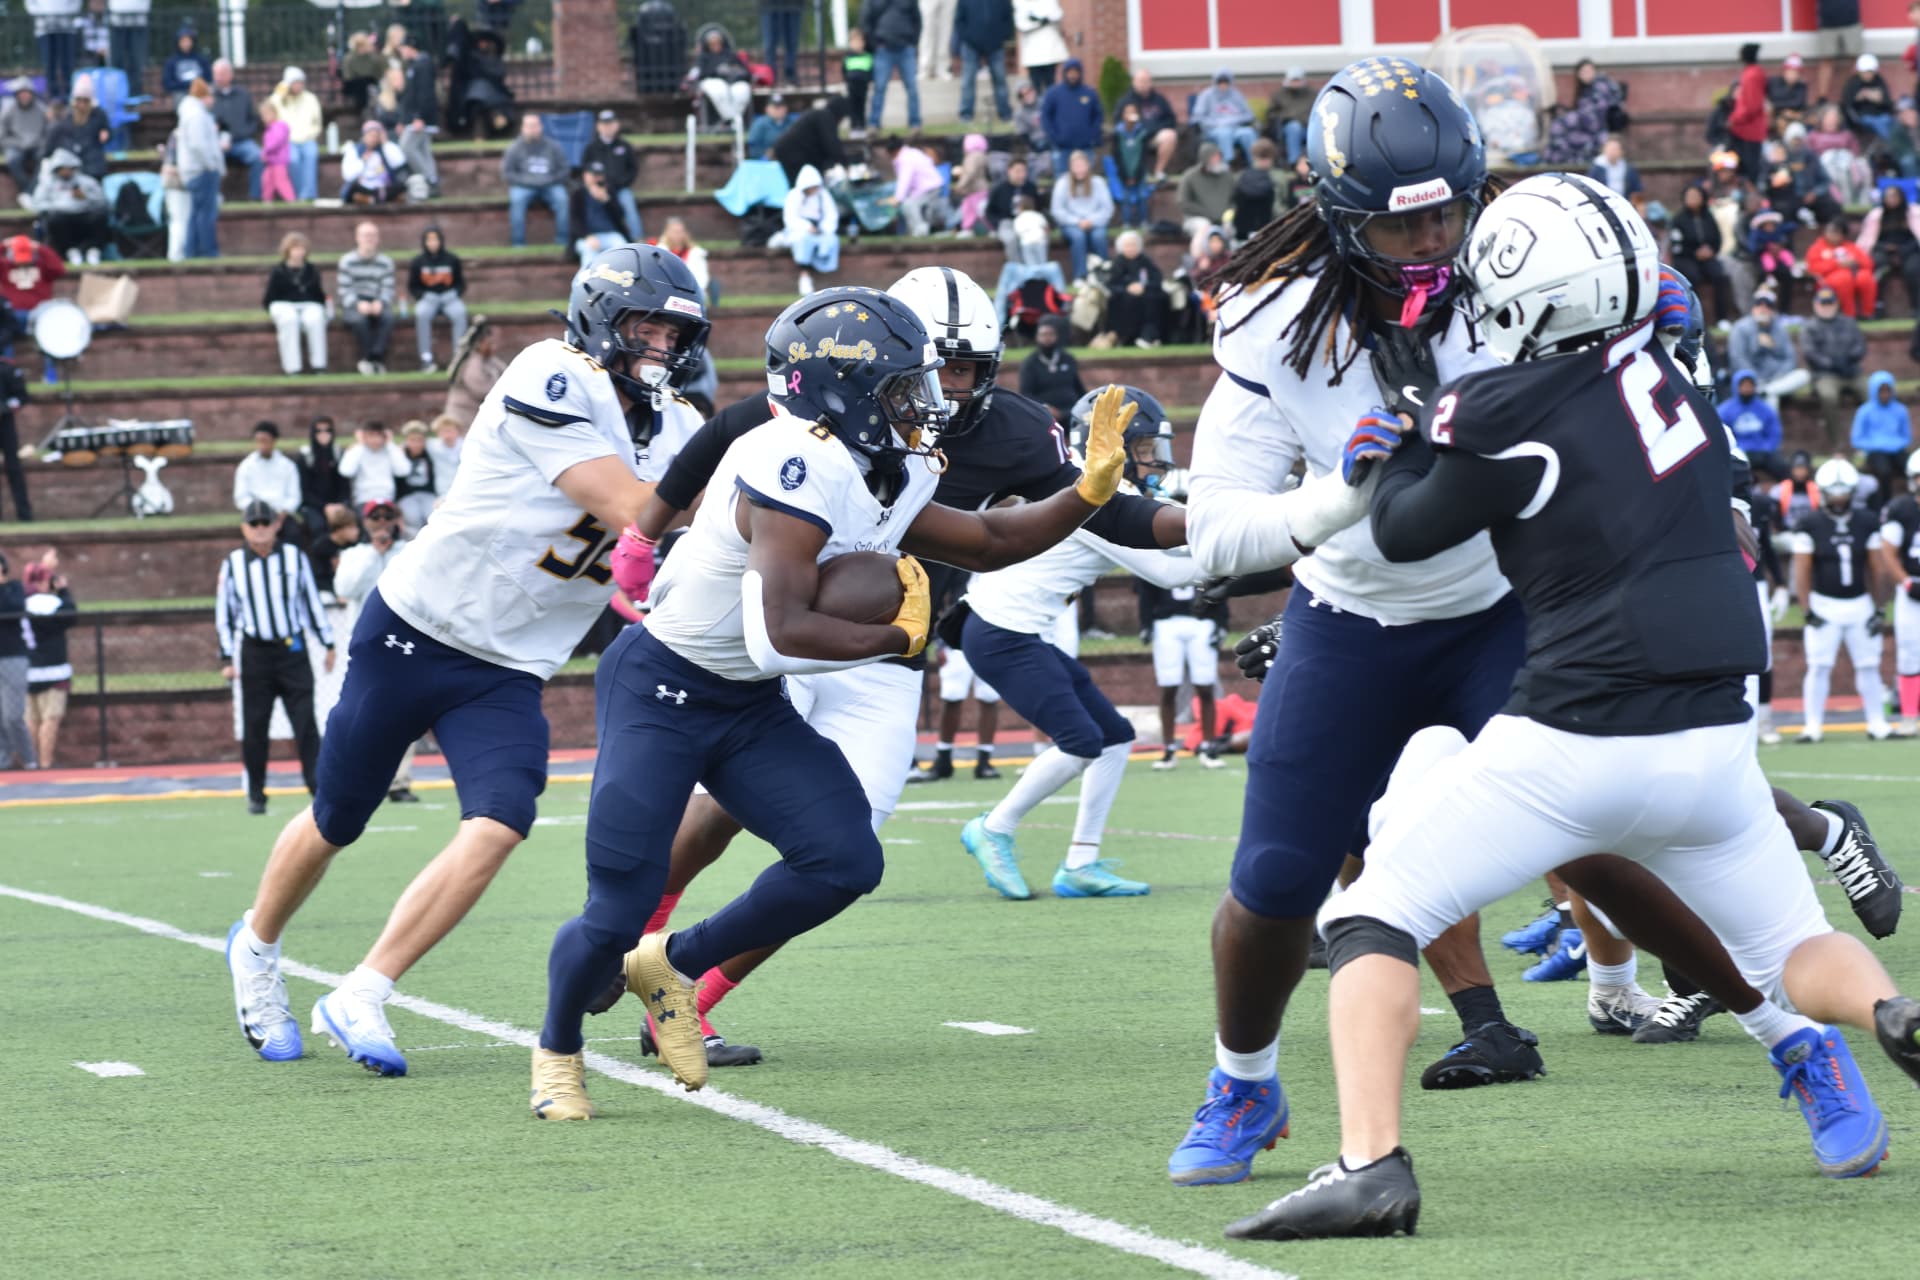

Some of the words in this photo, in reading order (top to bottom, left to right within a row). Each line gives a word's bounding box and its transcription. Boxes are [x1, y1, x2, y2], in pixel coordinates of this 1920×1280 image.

[1396, 187, 1445, 206] Riddell
[1609, 296, 1619, 311] 2
[788, 341, 812, 364] St.
[815, 336, 877, 361] Paul's
[1603, 314, 1711, 482] 2
[1430, 391, 1460, 446] 2
[1837, 543, 1852, 587] 1
